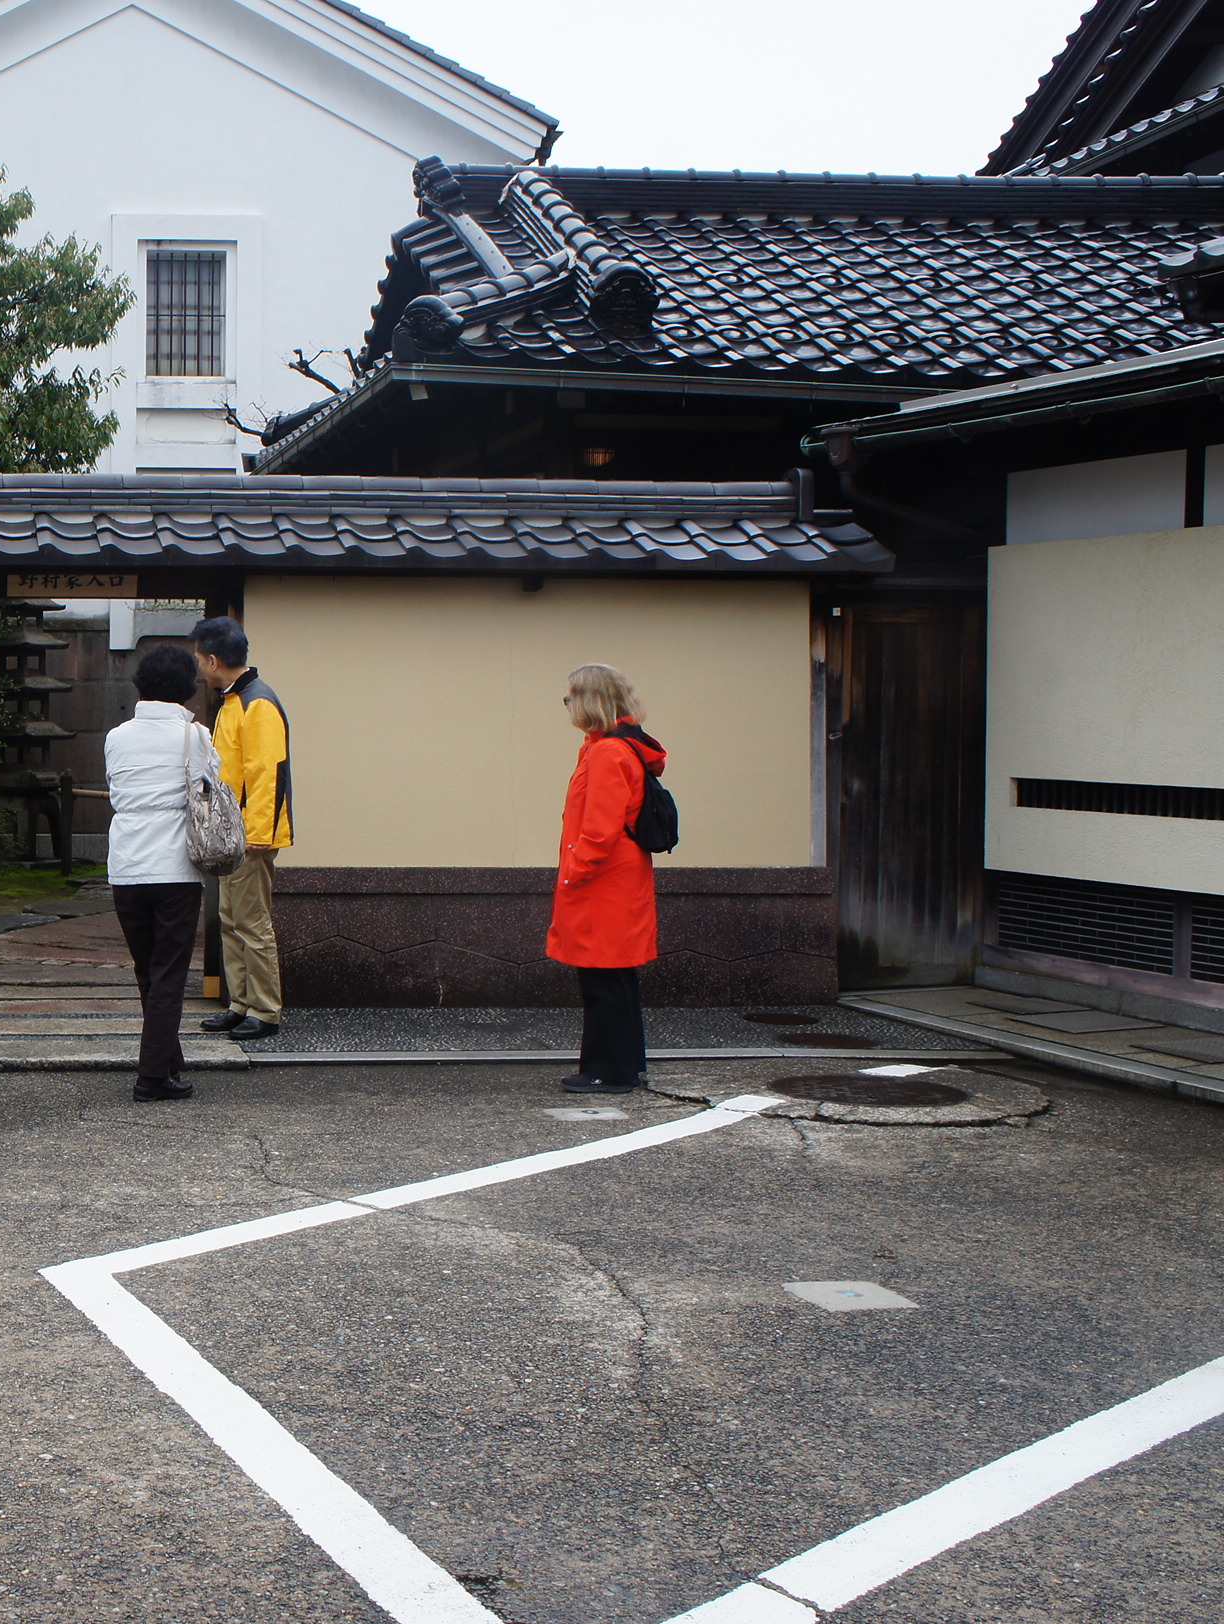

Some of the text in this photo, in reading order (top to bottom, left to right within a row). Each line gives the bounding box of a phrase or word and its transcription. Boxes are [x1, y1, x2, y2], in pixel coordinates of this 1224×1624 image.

[18, 575, 125, 589] 野村家入口
